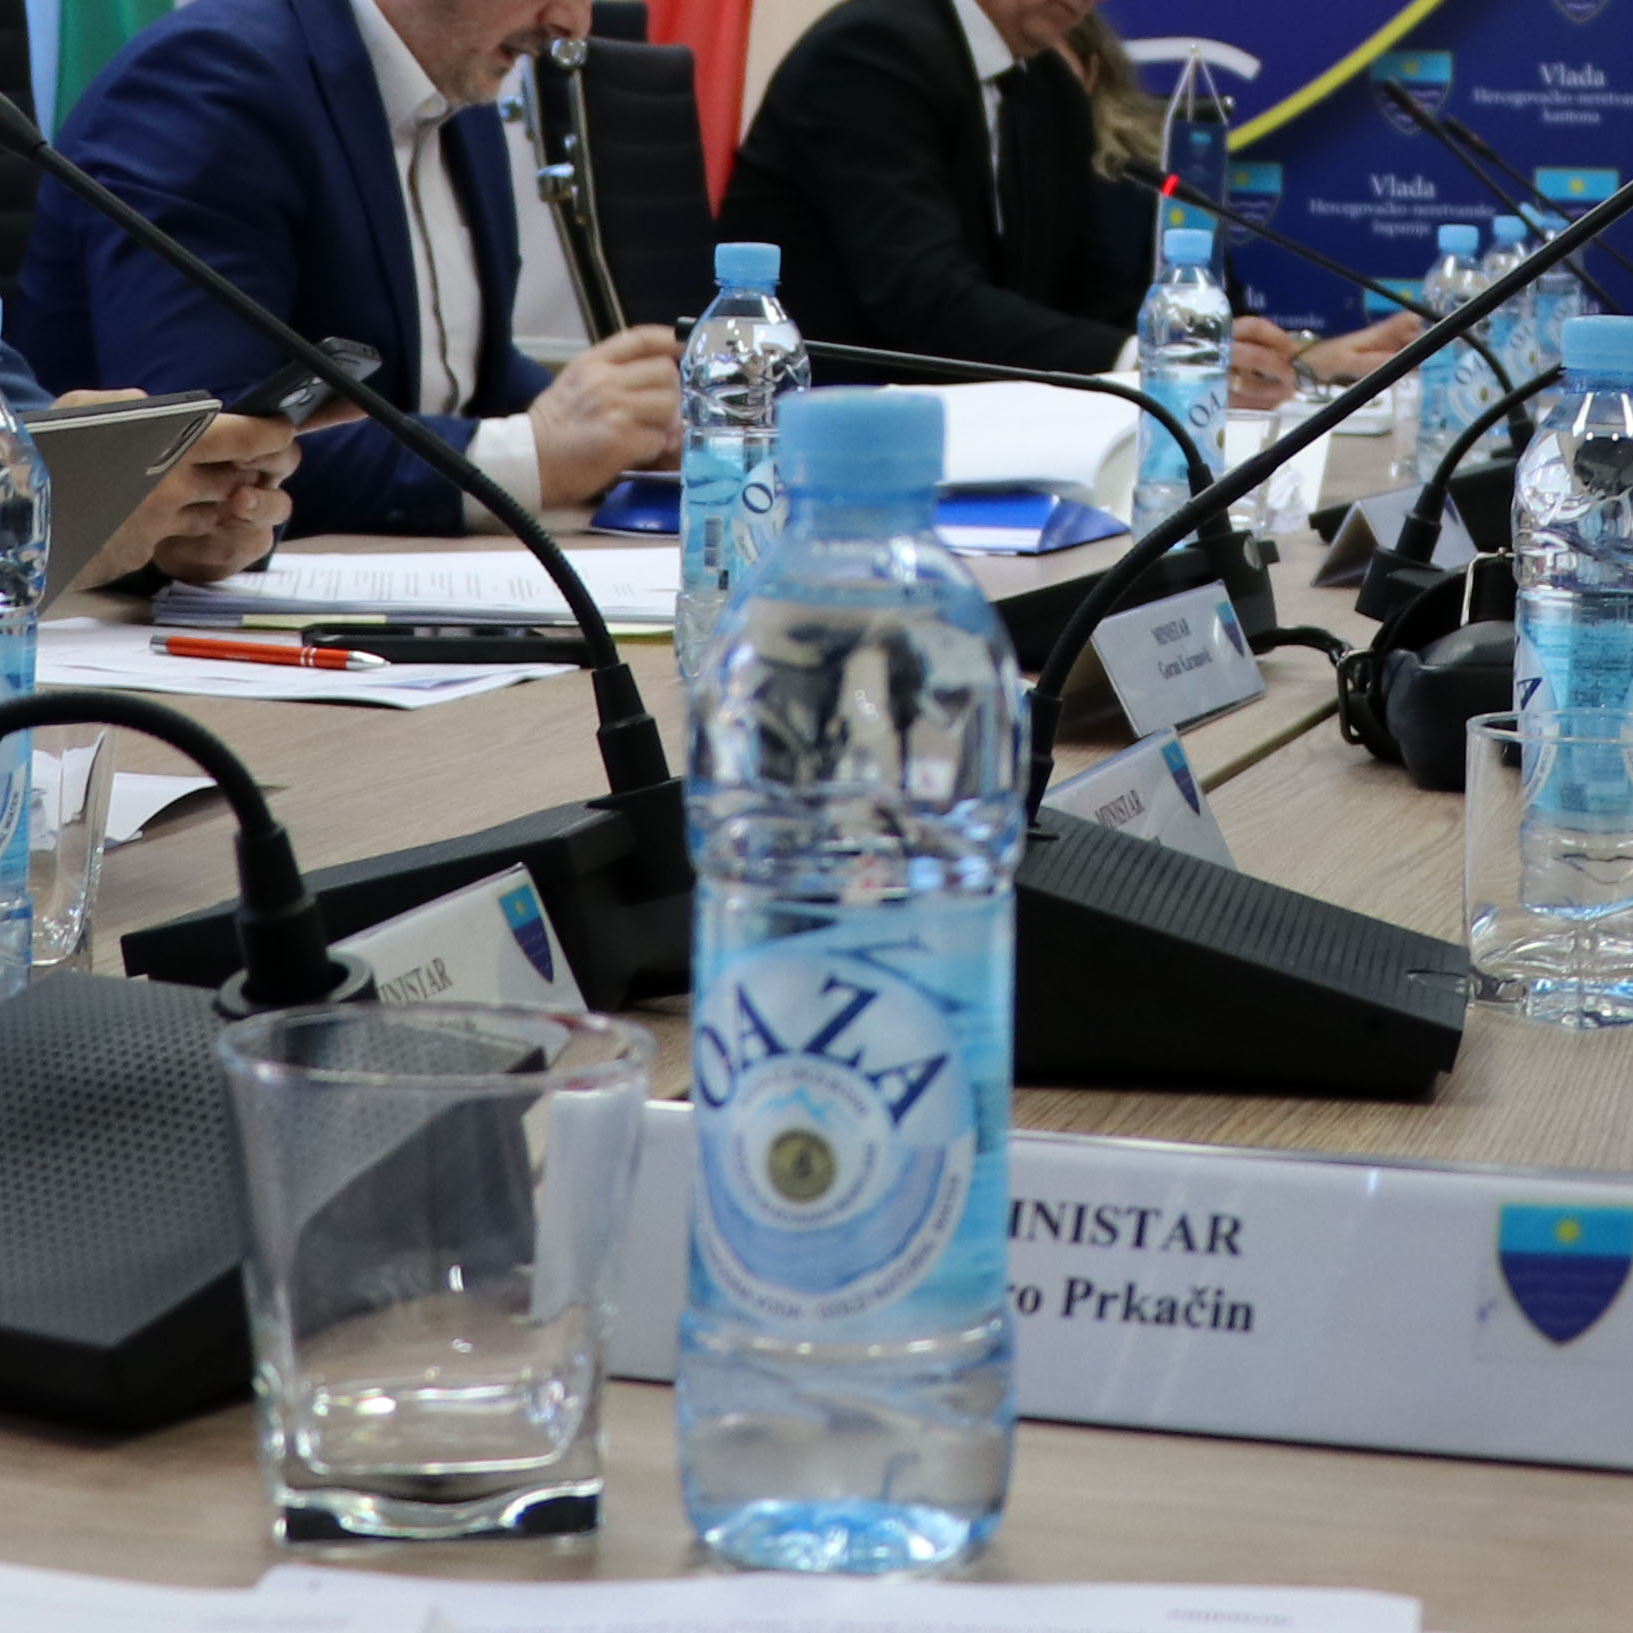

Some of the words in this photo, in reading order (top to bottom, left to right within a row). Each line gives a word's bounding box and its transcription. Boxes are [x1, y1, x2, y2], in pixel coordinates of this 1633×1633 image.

[1539, 62, 1606, 88] Vlada
[1370, 174, 1436, 199] Vlada
[380, 956, 454, 1005] INISTAR
[696, 975, 951, 1130] OAZA
[1006, 1198, 1244, 1257] INISTAR
[1060, 1276, 1256, 1332] Prkačin
